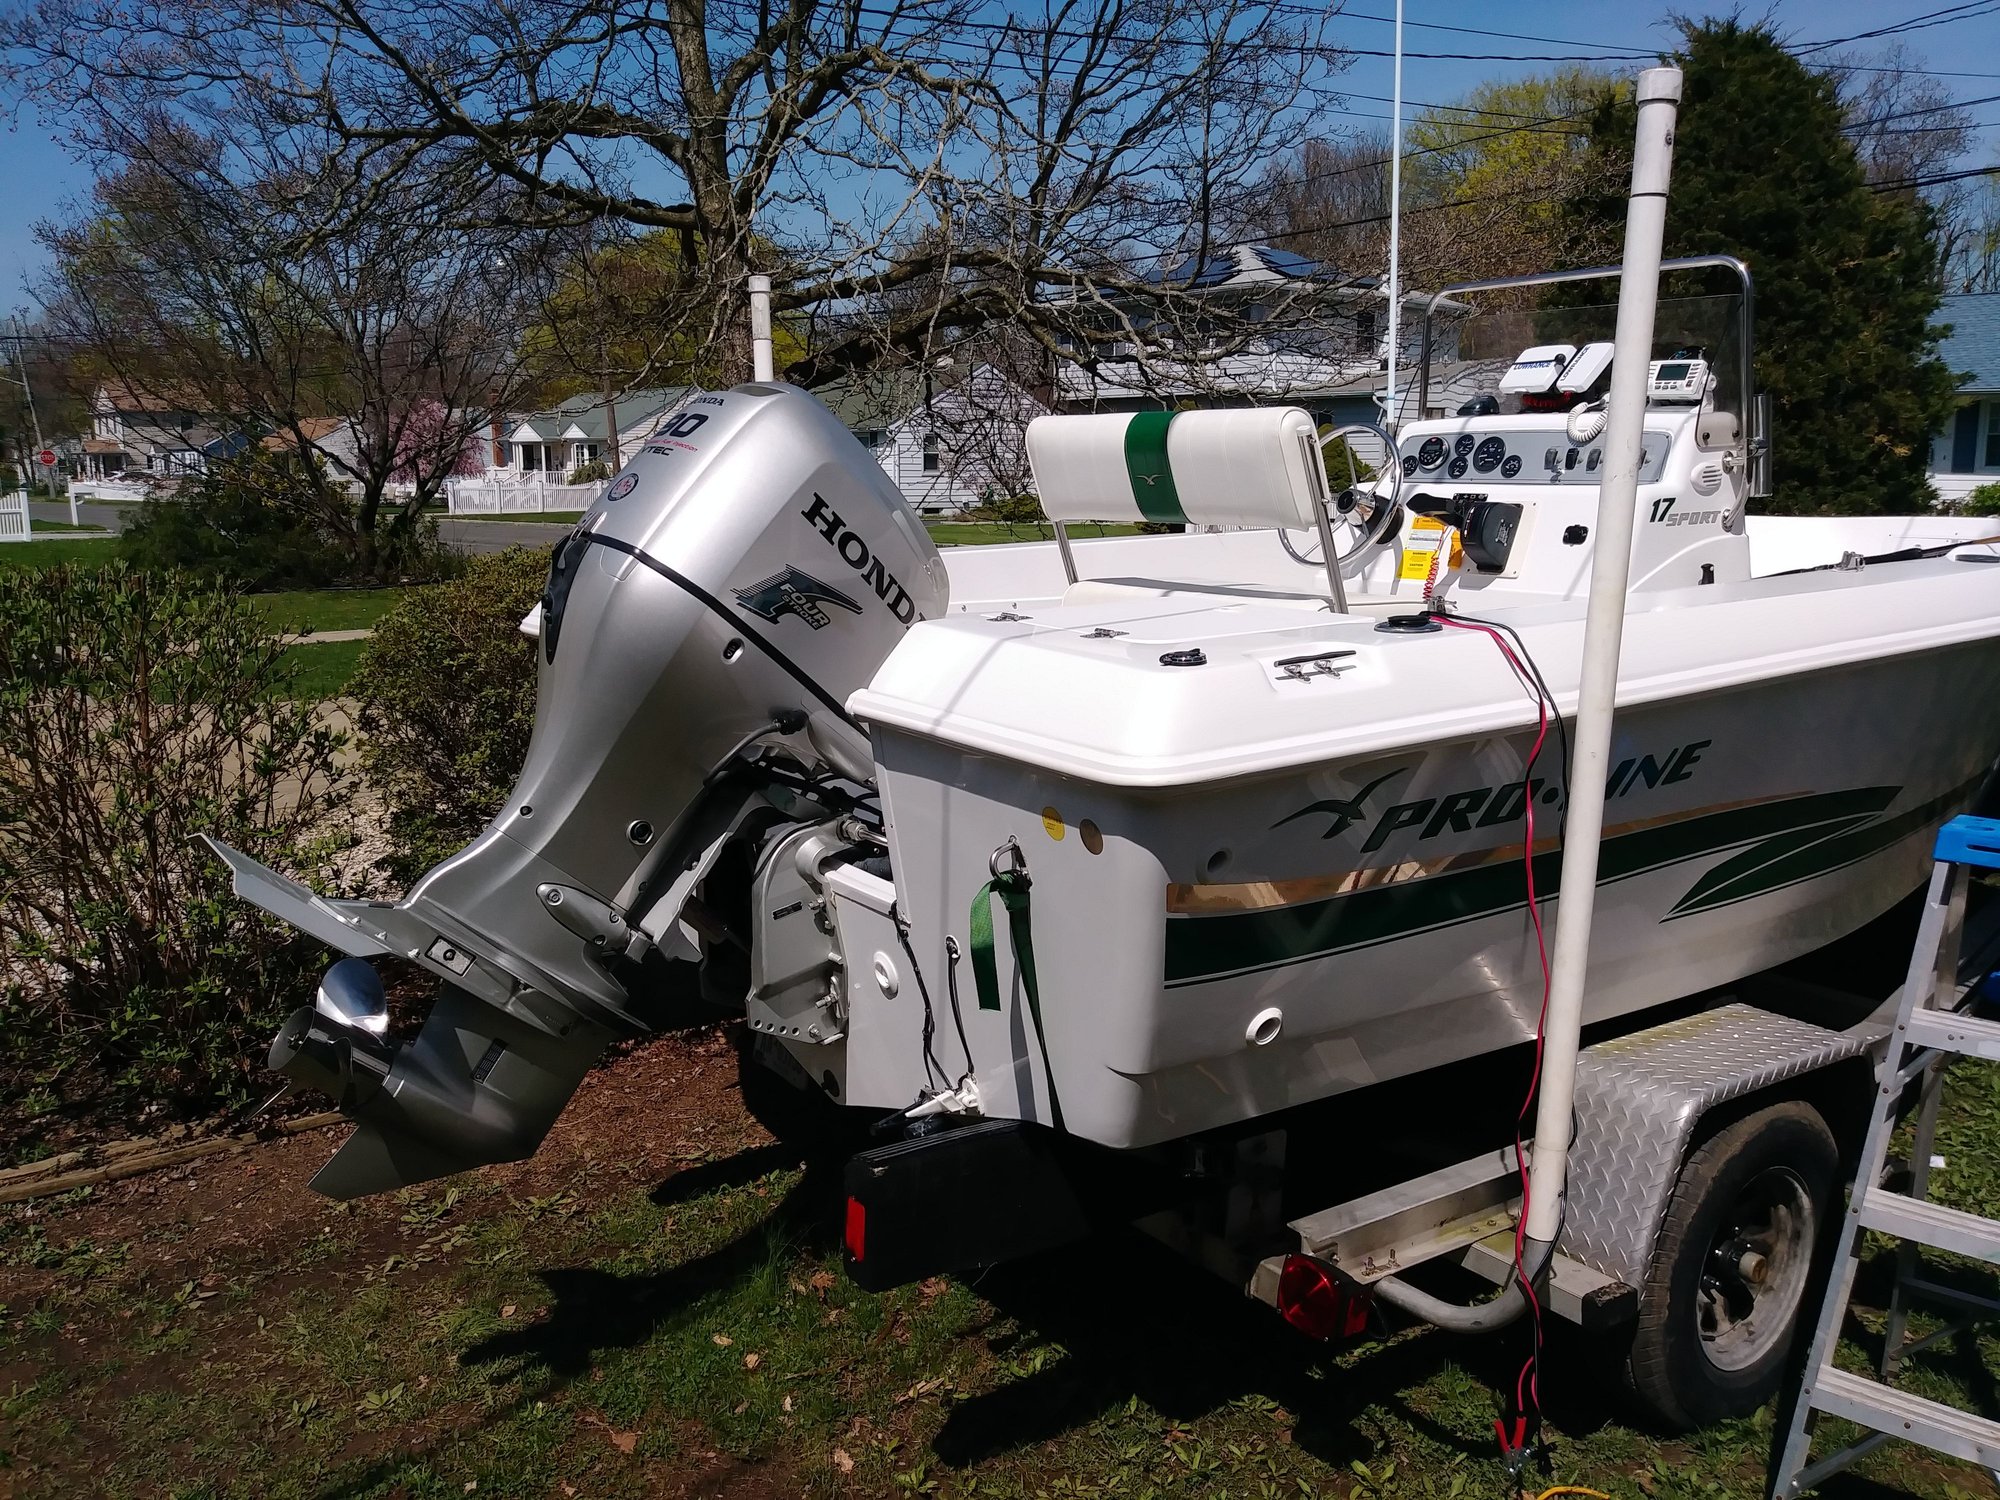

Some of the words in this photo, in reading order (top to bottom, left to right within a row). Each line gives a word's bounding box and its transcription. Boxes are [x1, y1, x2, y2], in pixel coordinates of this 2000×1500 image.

[690, 396, 725, 407] ONDA
[1649, 497, 1676, 523] 17
[1666, 511, 1721, 527] SPORT
[801, 492, 927, 630] HOND
[780, 583, 829, 625] FOUR
[781, 595, 821, 628] STROKE
